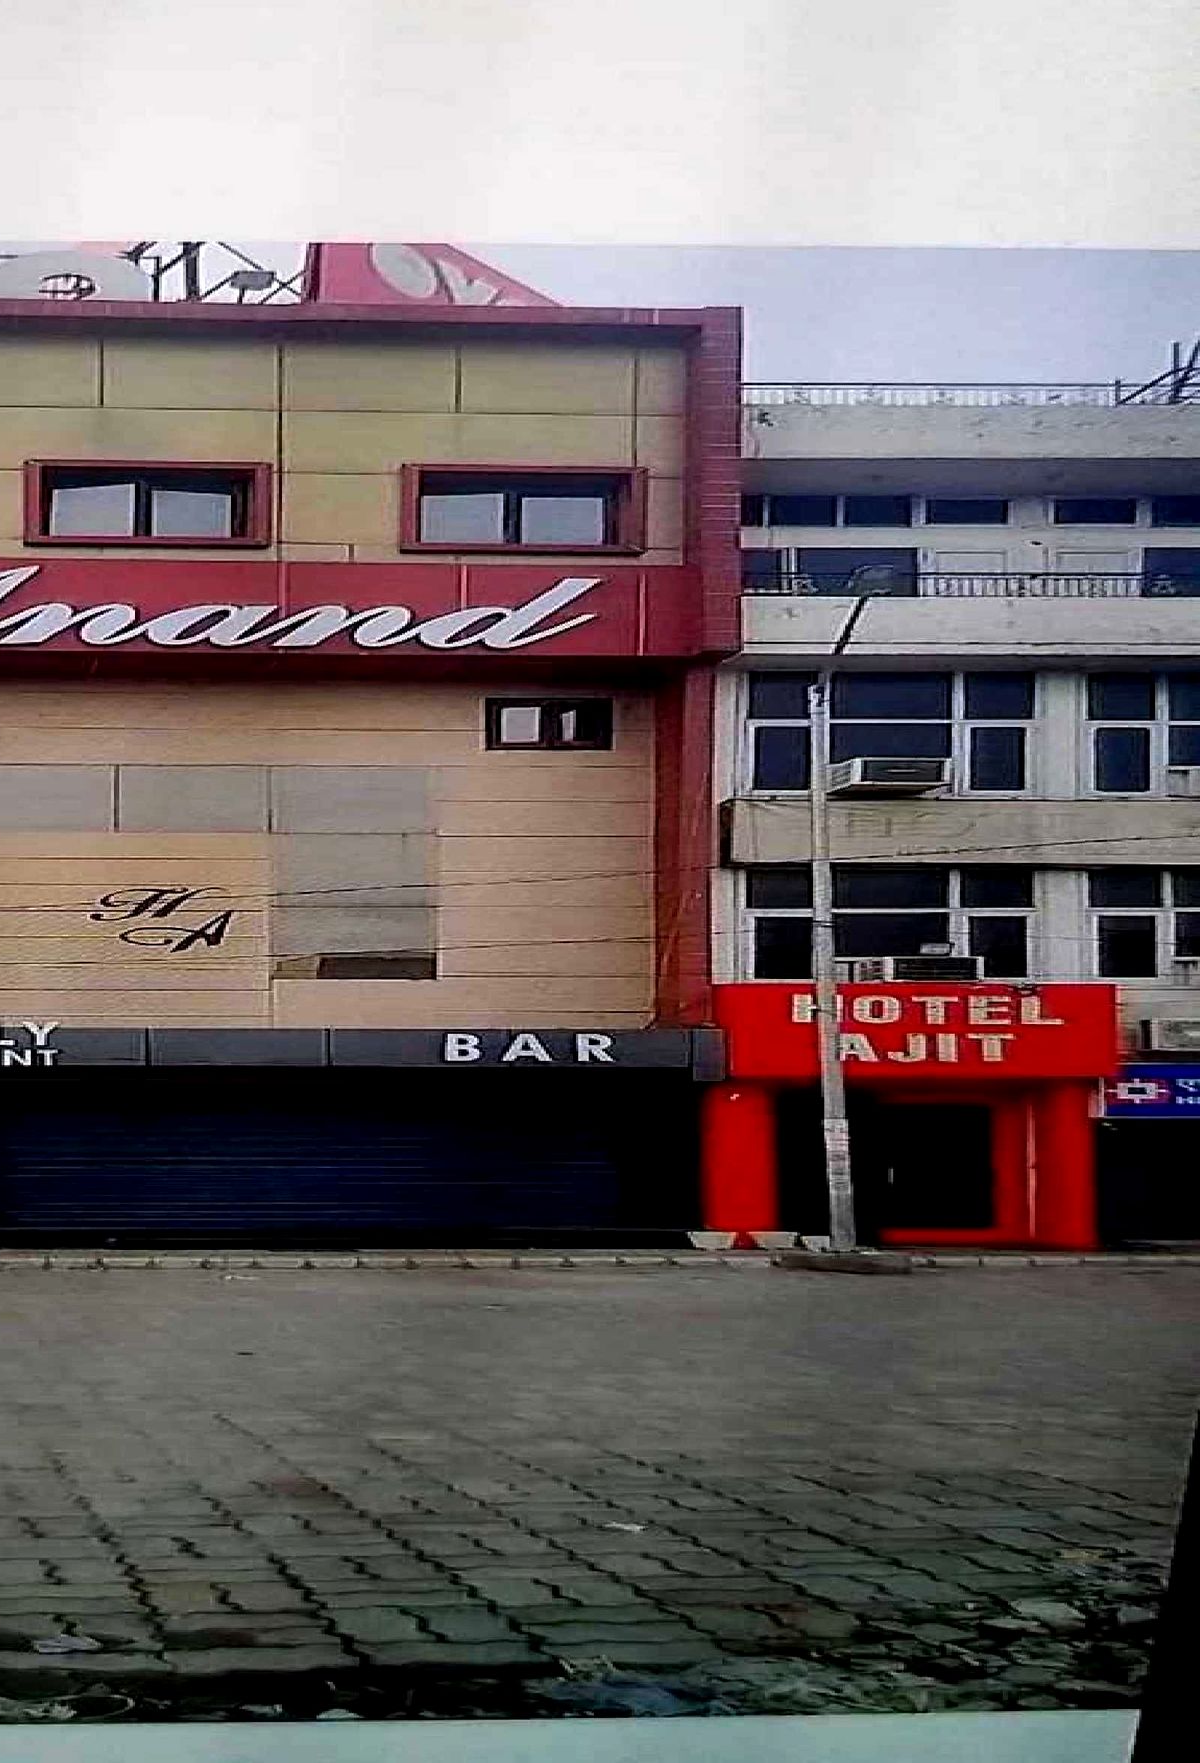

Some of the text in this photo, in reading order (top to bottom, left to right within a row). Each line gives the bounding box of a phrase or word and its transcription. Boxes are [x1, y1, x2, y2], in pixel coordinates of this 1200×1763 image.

[791, 993, 1065, 1026] HOTEL
[444, 1032, 616, 1063] BAR
[837, 1032, 1017, 1063] AJIT
